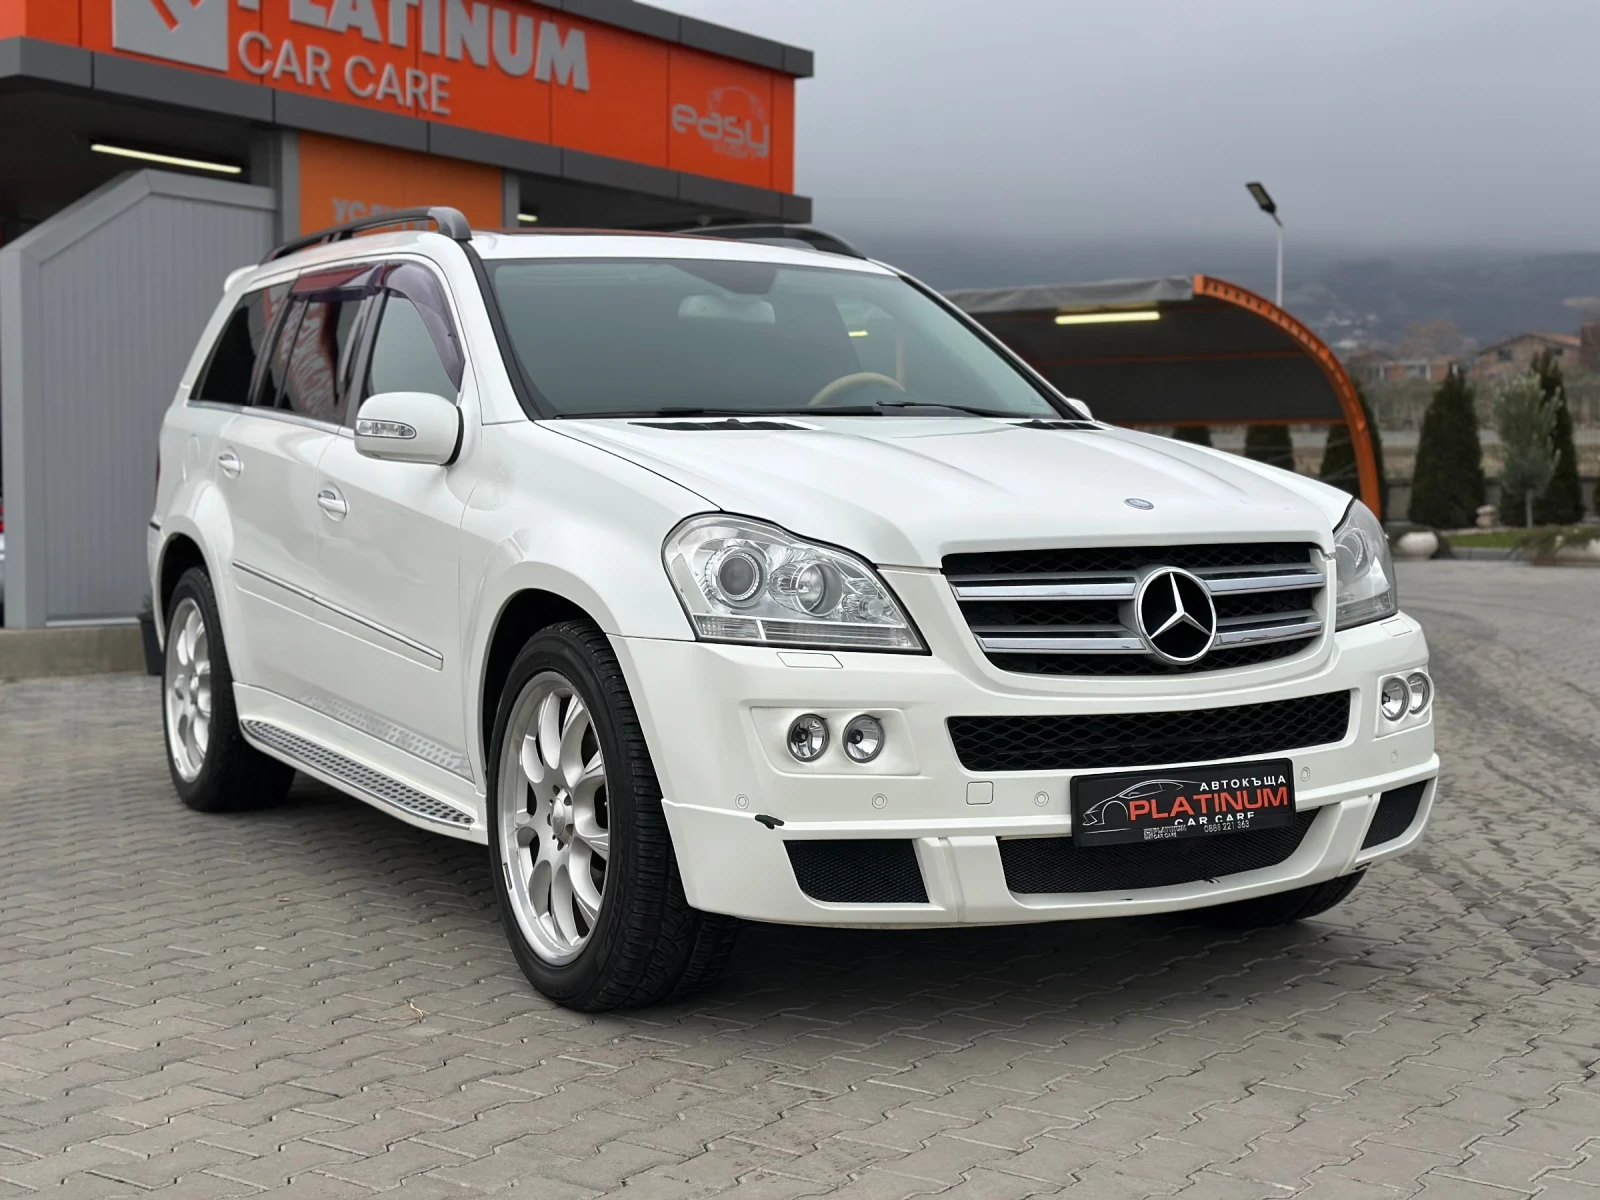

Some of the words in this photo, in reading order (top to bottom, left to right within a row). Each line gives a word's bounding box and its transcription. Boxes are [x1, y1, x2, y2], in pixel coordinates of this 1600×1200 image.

[237, 0, 590, 92] ATINUM
[238, 31, 332, 91] CAR
[344, 55, 451, 116] CARE
[672, 103, 770, 159] easy
[1199, 774, 1287, 792] АВТОКЪЩА
[1128, 786, 1289, 821] PLATINUM
[1174, 816, 1208, 827] CAR
[1222, 821, 1235, 831] 221
[1237, 819, 1250, 829] 363
